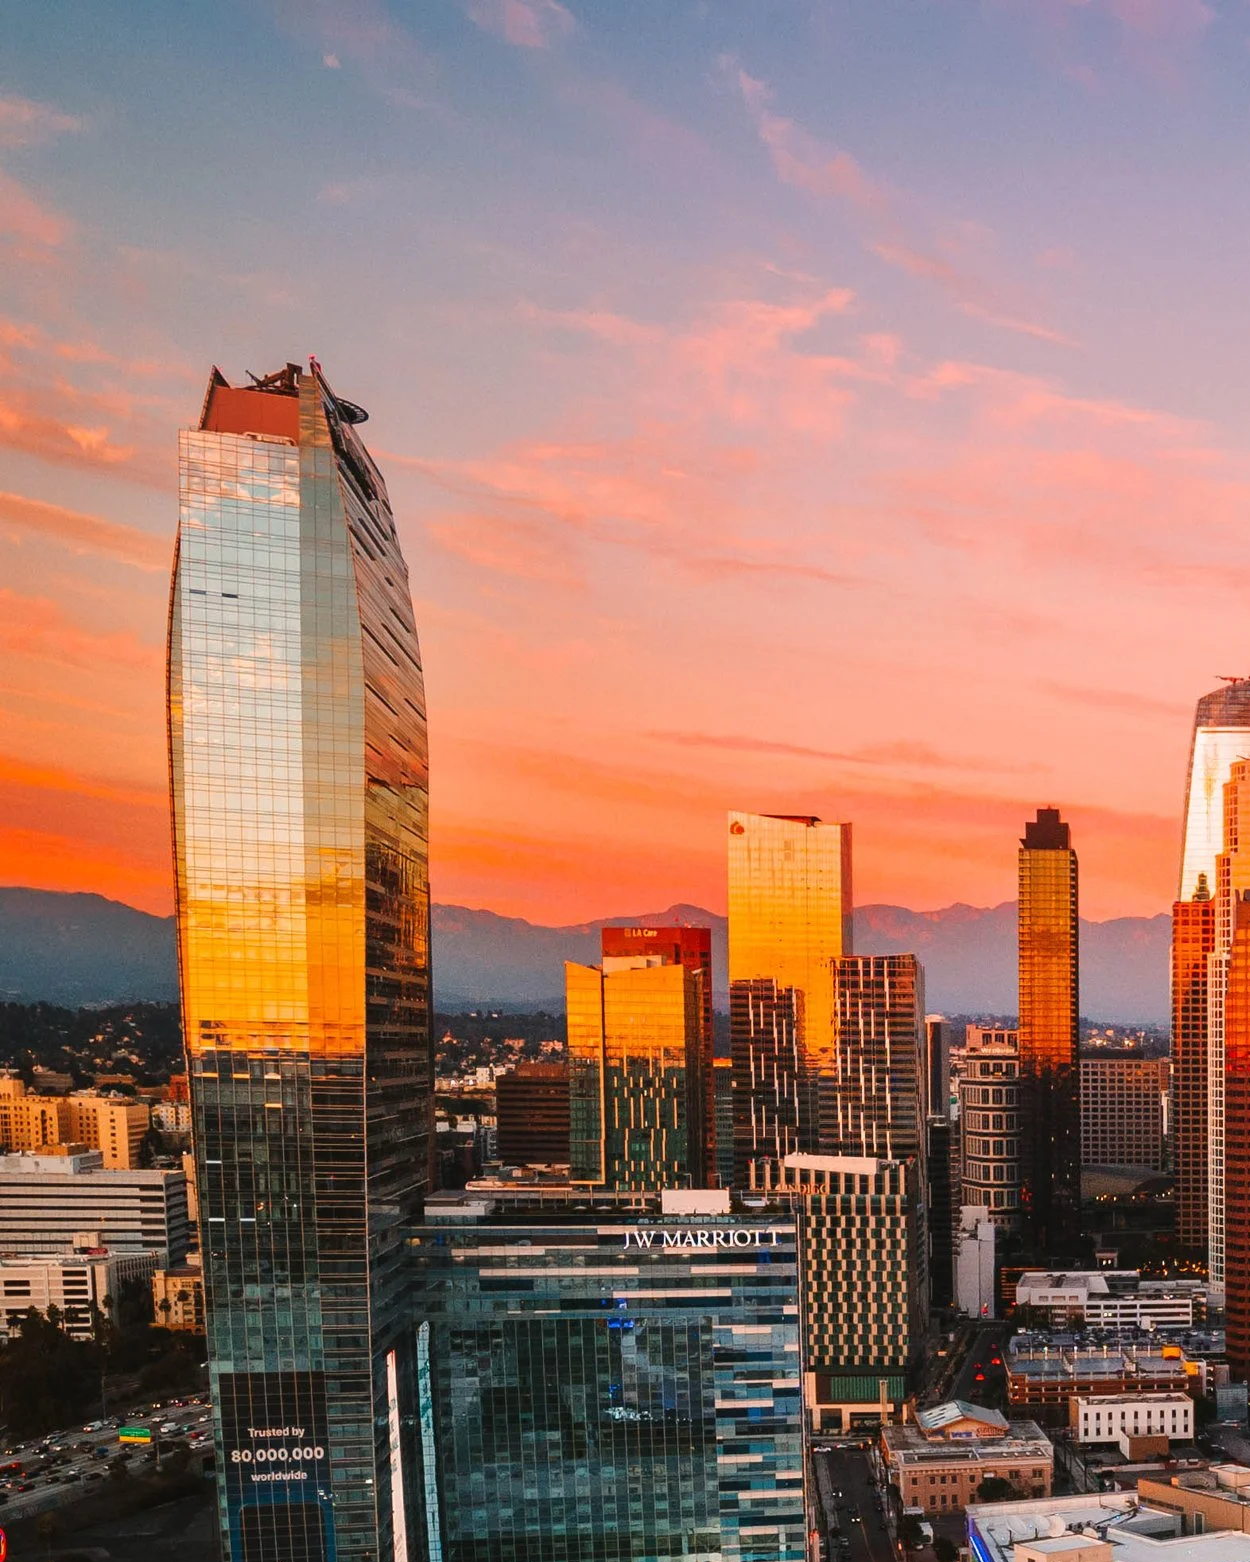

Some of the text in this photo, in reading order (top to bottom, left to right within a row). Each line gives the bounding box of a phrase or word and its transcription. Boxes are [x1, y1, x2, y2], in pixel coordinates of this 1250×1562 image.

[661, 1230, 782, 1248] MARRIOTT
[247, 1427, 305, 1438] Trusted by
[231, 1446, 325, 1464] 80,000,000
[251, 1470, 308, 1481] worldwide
